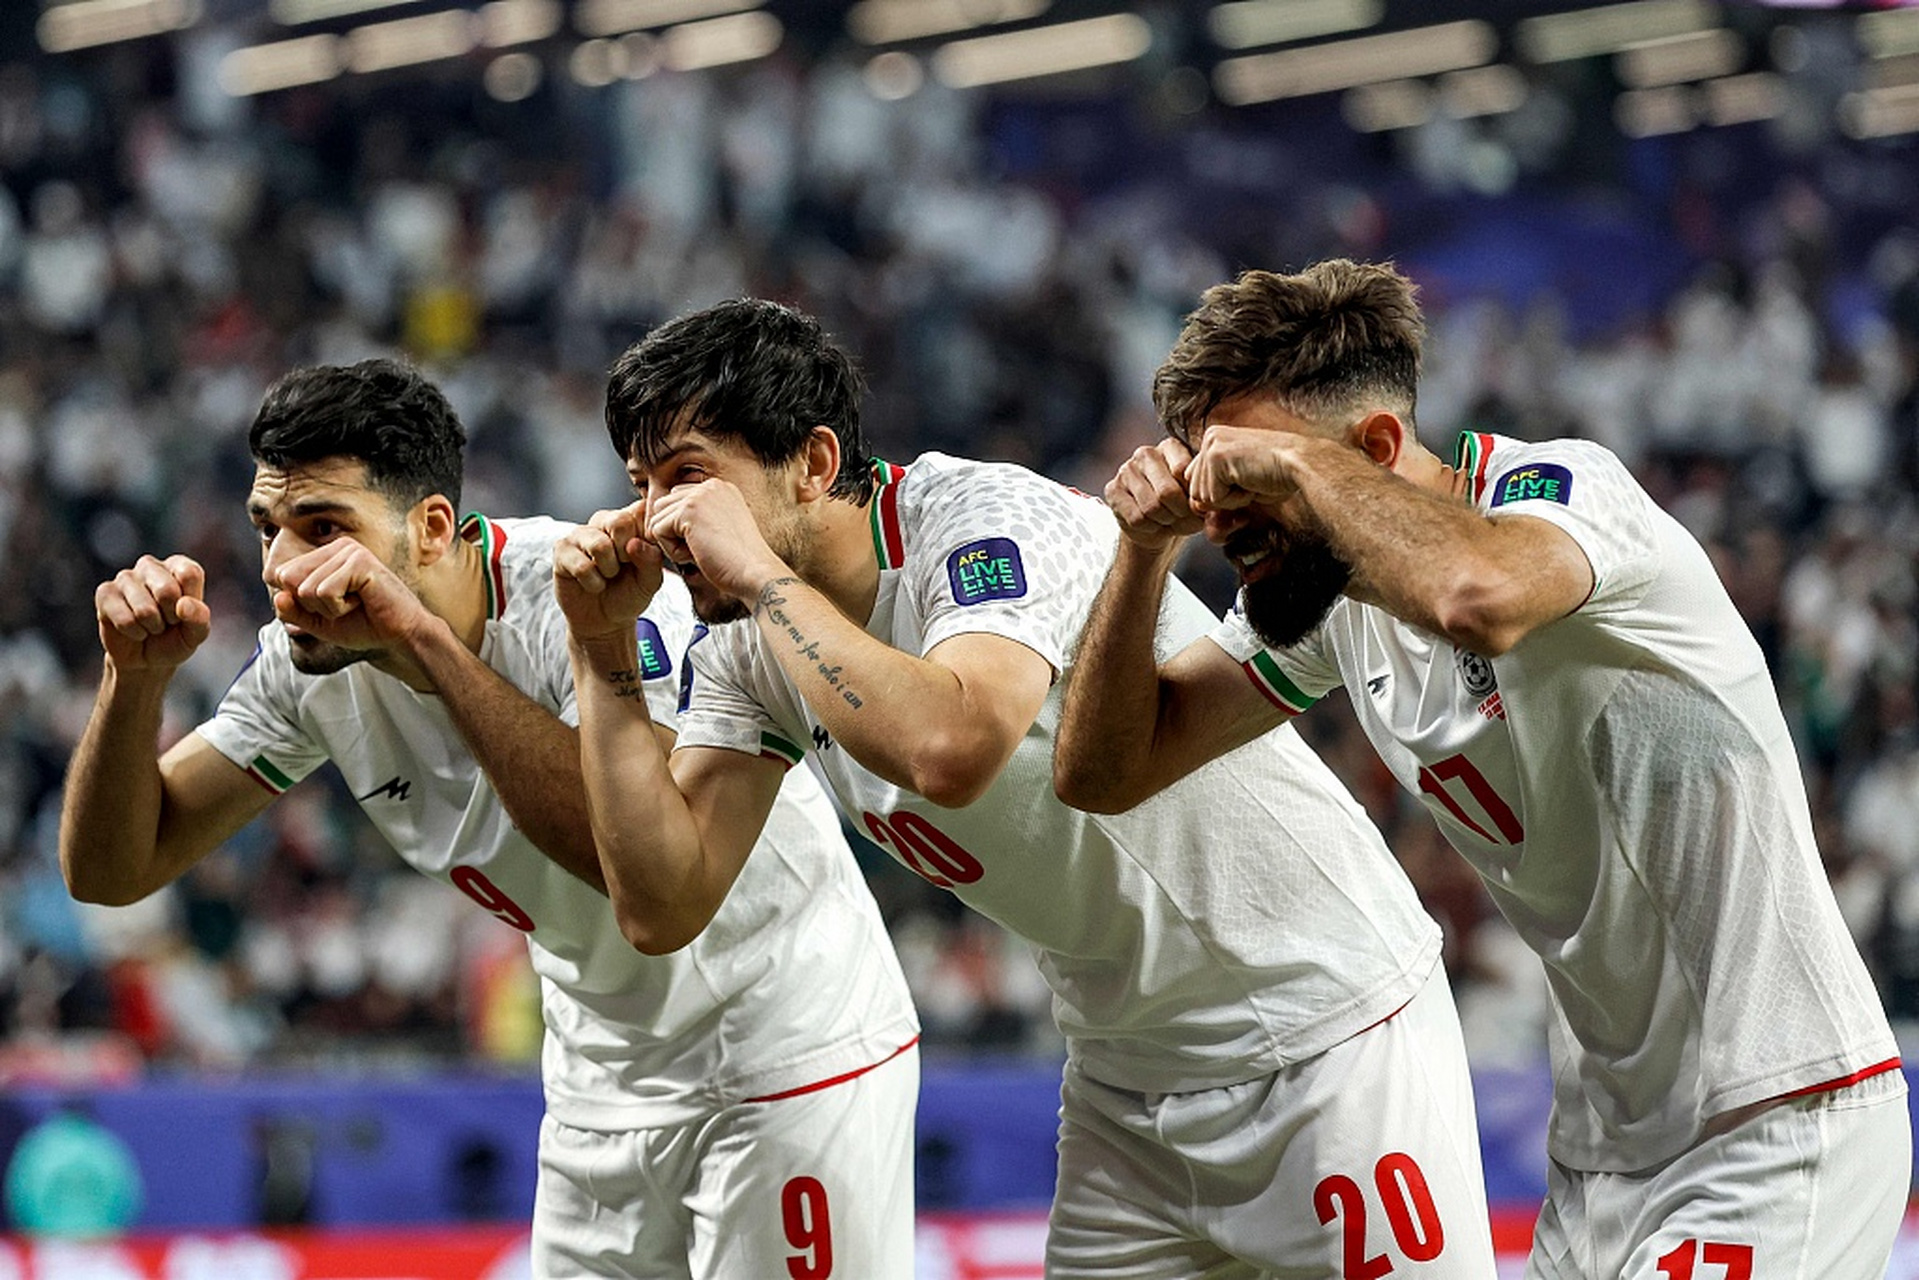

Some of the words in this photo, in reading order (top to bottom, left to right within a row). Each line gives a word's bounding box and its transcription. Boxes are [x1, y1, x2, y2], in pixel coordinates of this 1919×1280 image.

[1508, 470, 1540, 484] AFC
[959, 550, 989, 567] AFC
[960, 558, 1013, 582] LIVE
[788, 627, 805, 644] me
[1418, 753, 1525, 846] 17
[863, 810, 985, 888] 20
[450, 865, 536, 933] 9
[781, 1176, 833, 1280] 9
[1313, 1152, 1444, 1280] 20
